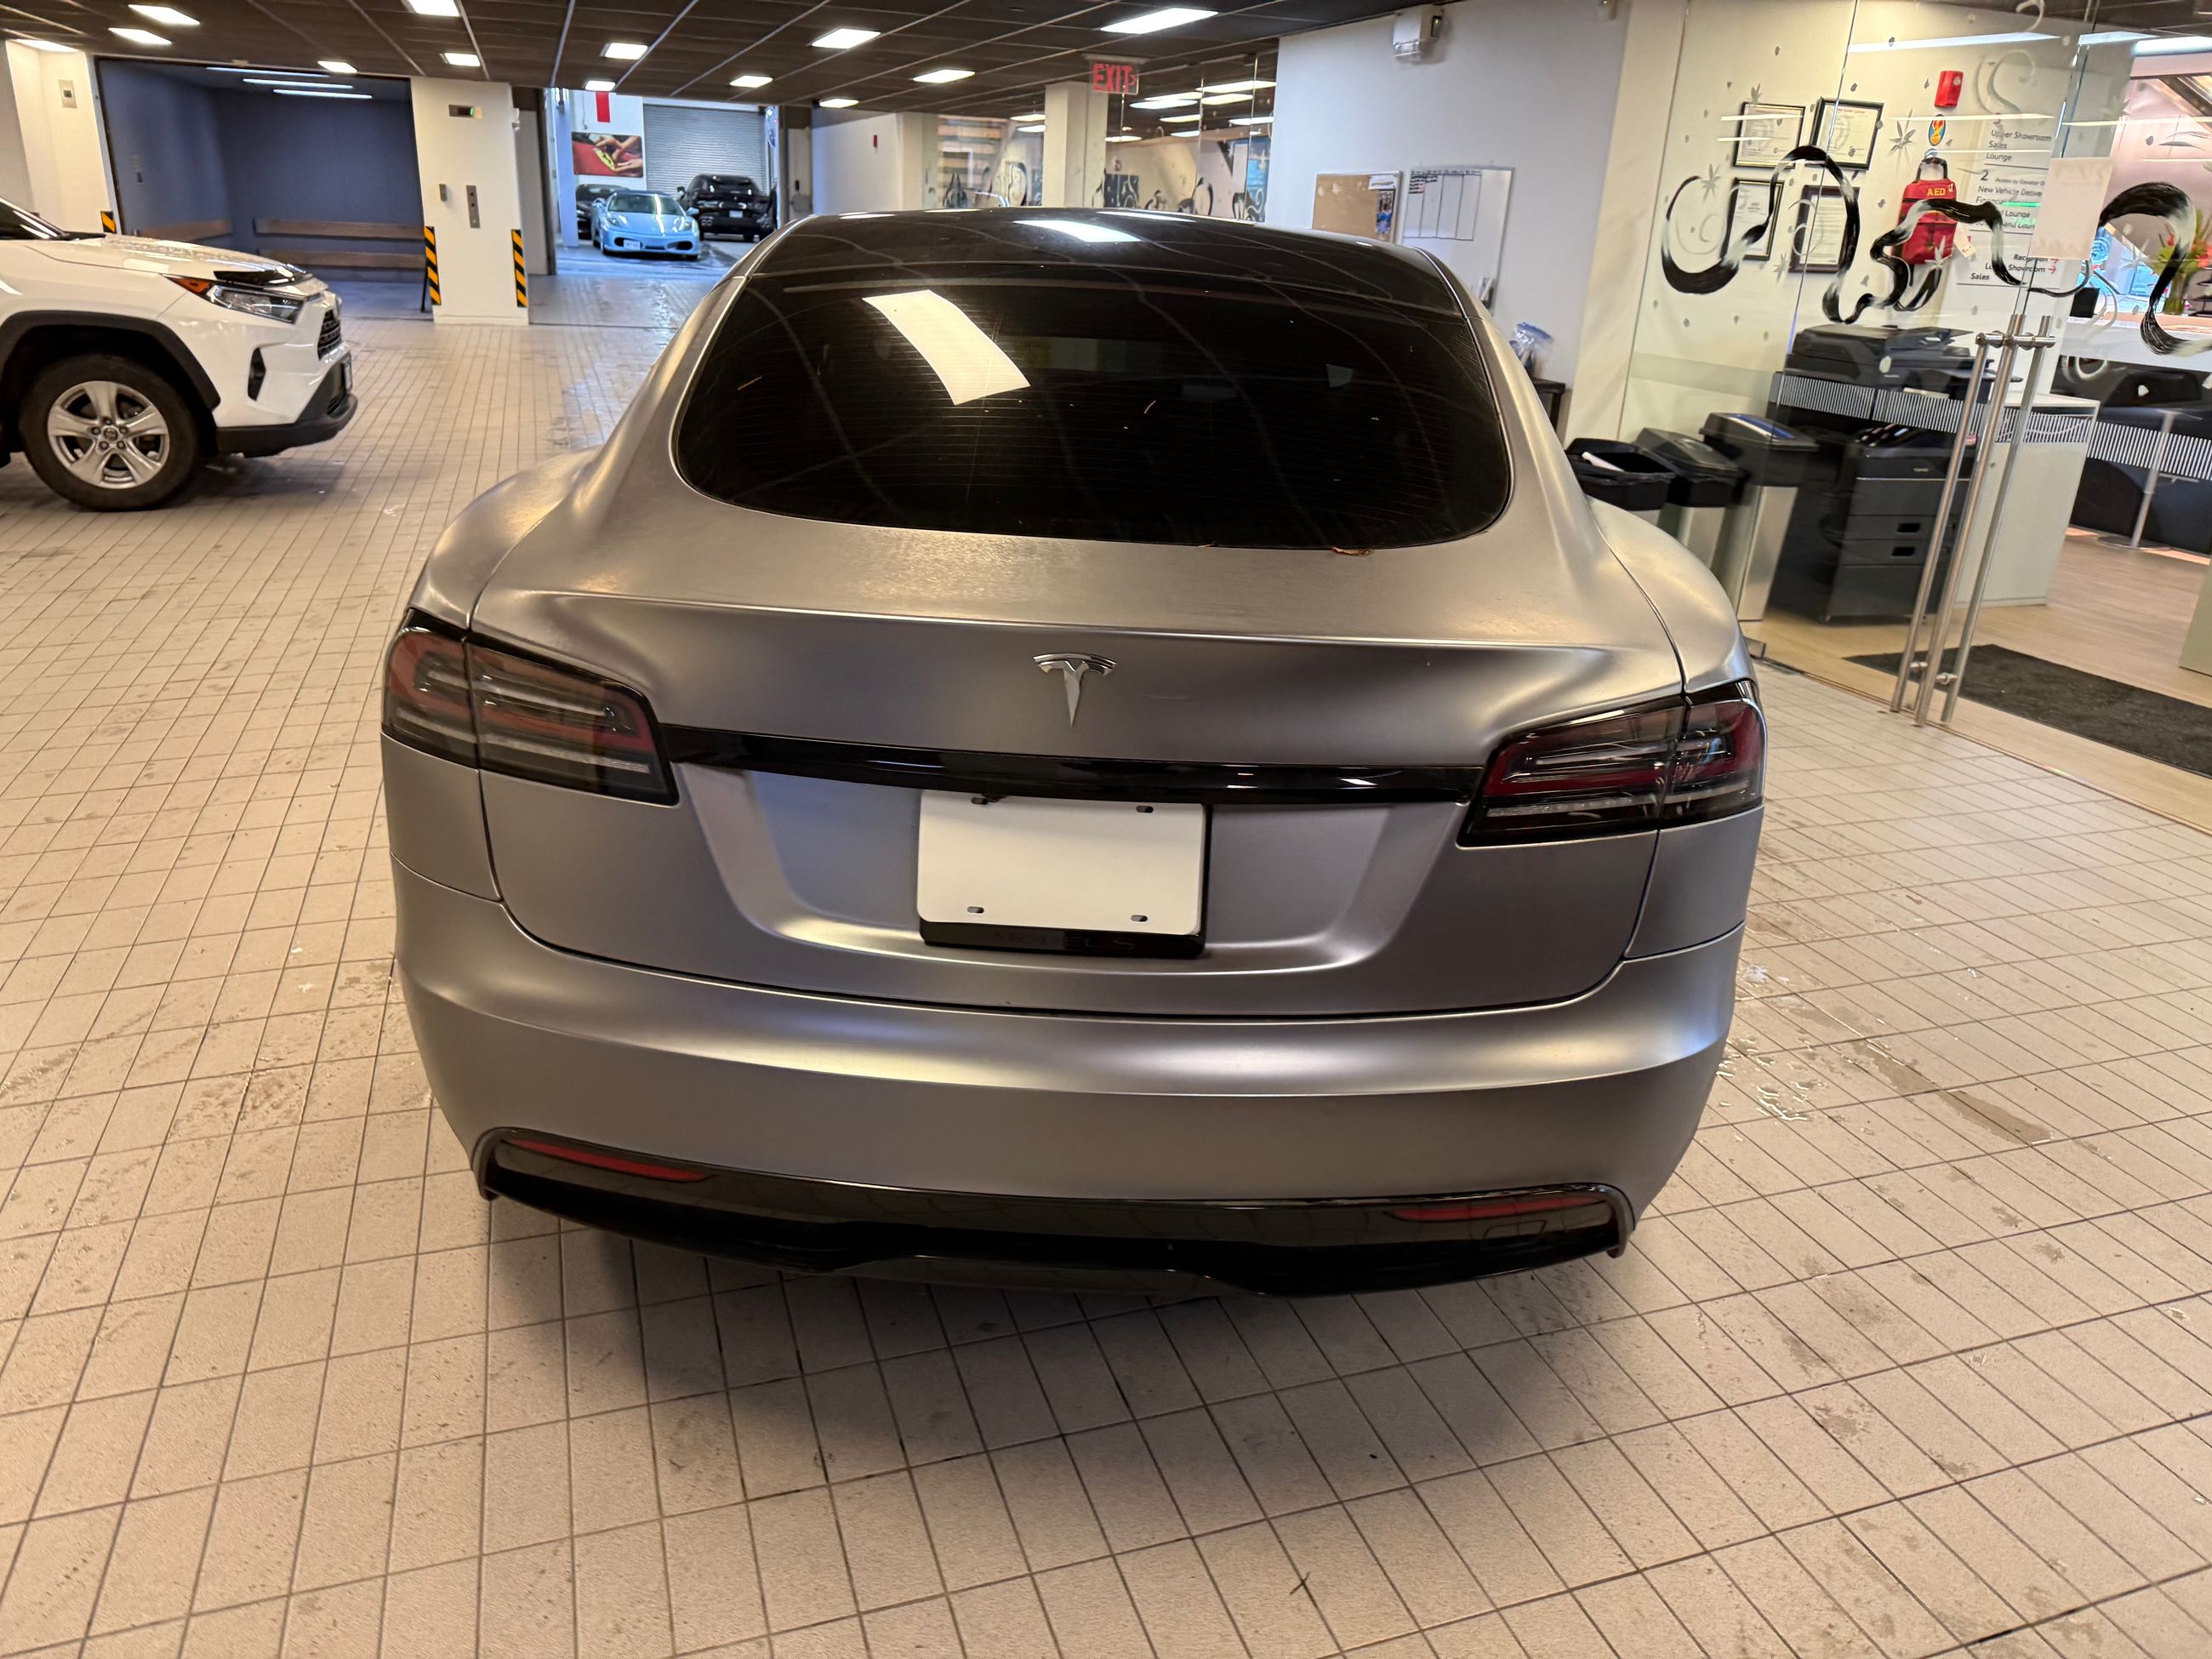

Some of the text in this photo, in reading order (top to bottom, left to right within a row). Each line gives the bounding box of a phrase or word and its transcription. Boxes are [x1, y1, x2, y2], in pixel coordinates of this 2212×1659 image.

[1092, 63, 1132, 94] EXIT
[1991, 128, 2052, 141] Uper Showroom
[1986, 152, 2013, 162] Lounge
[1981, 169, 1989, 181] 2
[1926, 187, 1947, 197] AED
[1978, 185, 1994, 194] New
[1995, 186, 2020, 196] Vehicle
[2004, 210, 2031, 219] Lounge
[1970, 272, 1990, 281] Sales
